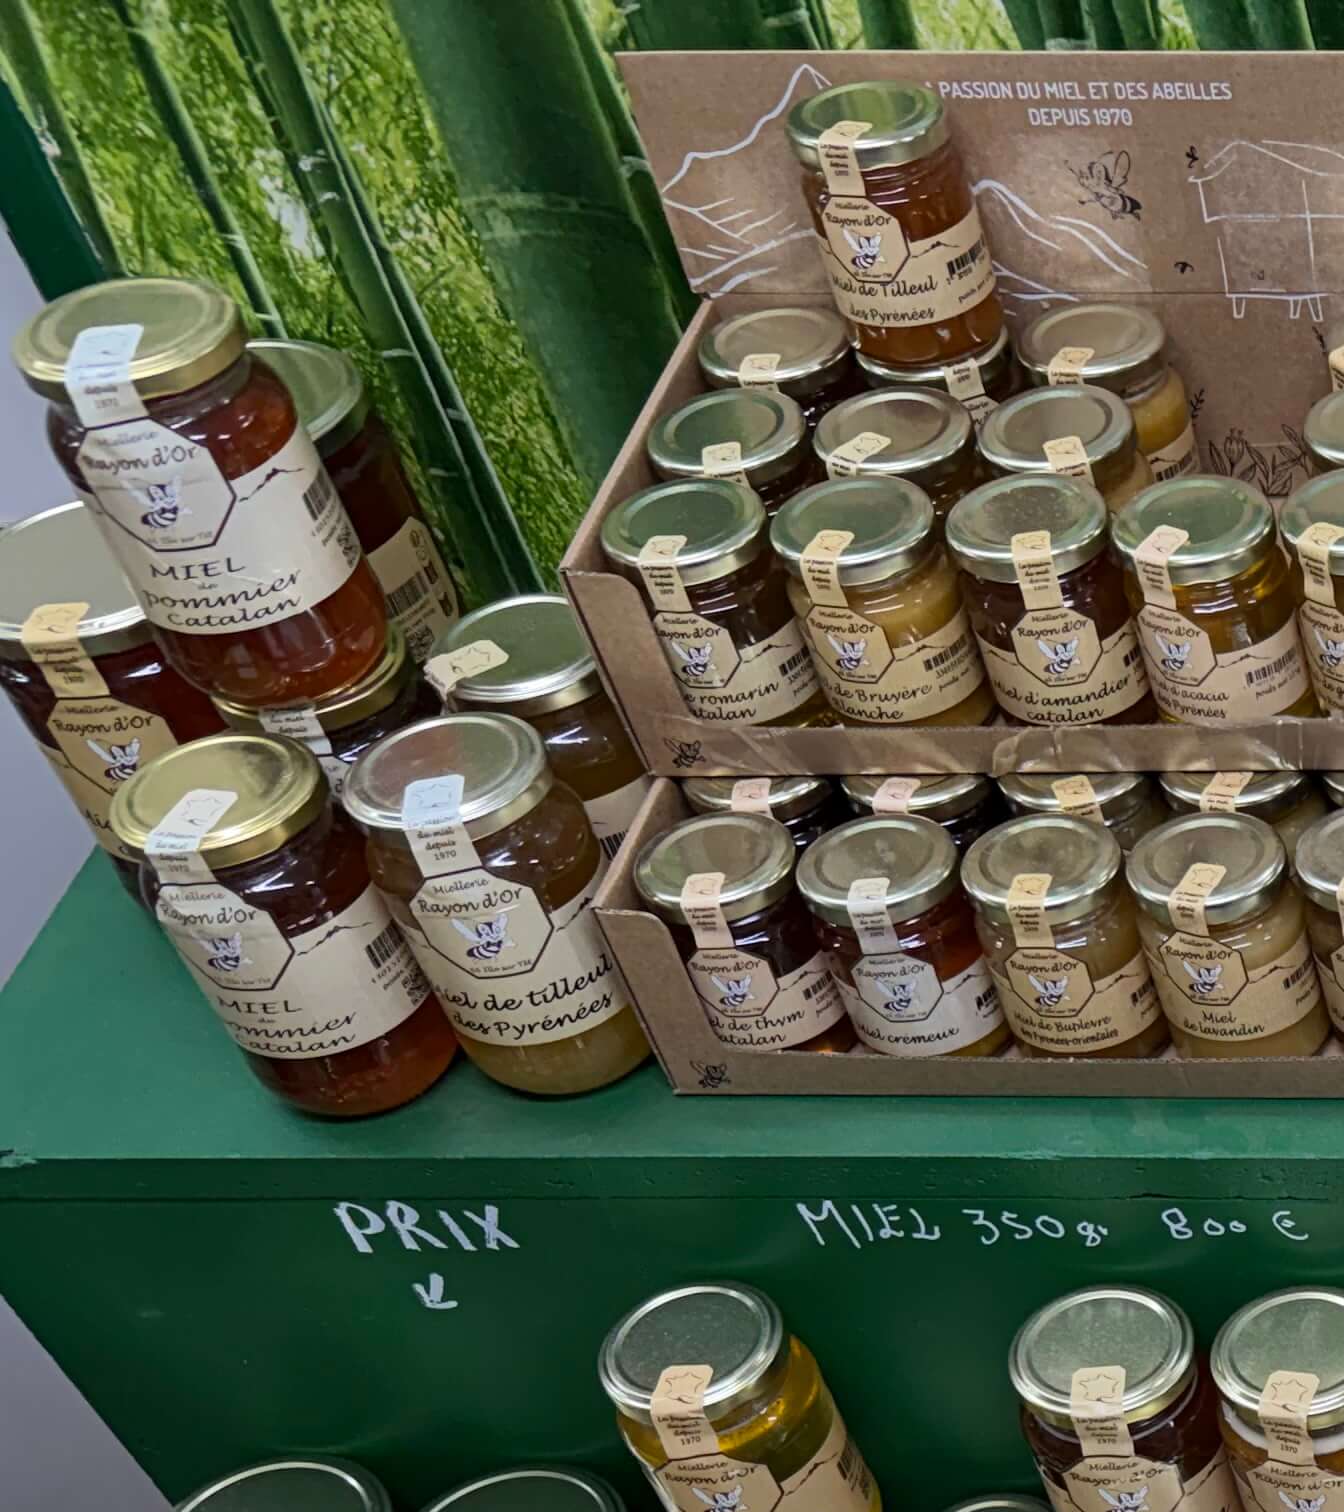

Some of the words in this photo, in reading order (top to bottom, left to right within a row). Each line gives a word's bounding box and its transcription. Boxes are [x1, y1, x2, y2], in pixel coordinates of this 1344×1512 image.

[939, 81, 1012, 100] PASSION
[1016, 82, 1040, 100] DU
[1044, 82, 1085, 100] MIEL
[1088, 83, 1110, 100] ET
[1113, 83, 1149, 100] DES
[1152, 82, 1232, 100] ABEILLES
[1028, 108, 1092, 127] DEPUIS
[1093, 109, 1133, 127] 1970
[880, 276, 938, 299] Tilleul
[150, 556, 246, 580] MIEL
[698, 681, 780, 704] romarin
[857, 681, 934, 708] Bruyère
[1024, 673, 1131, 707] d'amandier
[1026, 707, 1105, 722] catalan
[432, 876, 489, 896] Miellerie
[481, 989, 524, 1014] de
[525, 952, 614, 1004] tilleul
[493, 990, 614, 1042] Pyrénées
[754, 1008, 805, 1031] thym
[886, 1027, 960, 1045] crémeux
[1197, 1021, 1266, 1037] lavandin
[334, 1200, 520, 1254] PRIX
[796, 1199, 941, 1248] MIEL
